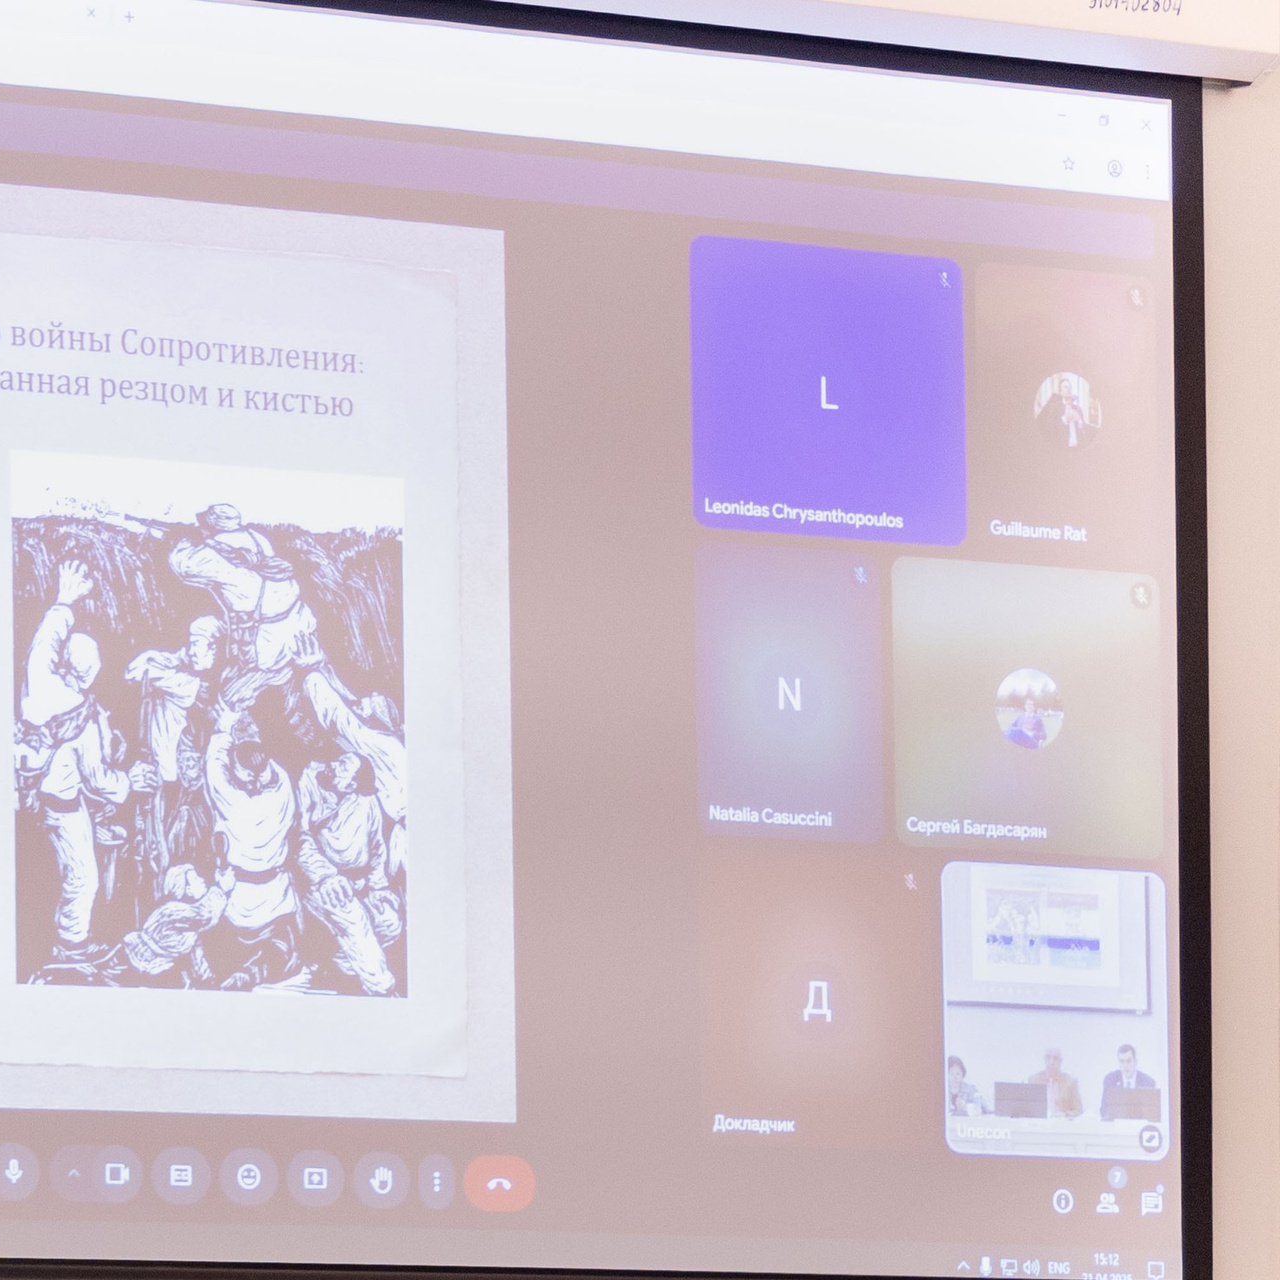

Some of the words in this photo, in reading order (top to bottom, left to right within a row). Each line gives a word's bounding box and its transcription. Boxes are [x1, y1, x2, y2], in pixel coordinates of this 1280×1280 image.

[10, 321, 112, 354] войны
[120, 328, 366, 375] Сопротивления:
[99, 376, 208, 408] резцом
[217, 387, 235, 408] и
[244, 388, 354, 418] кистью
[820, 376, 839, 410] L
[704, 498, 770, 519] Leonidas
[772, 503, 904, 530] Chrysanthopoulos
[989, 519, 1062, 542] Guillaume
[1063, 525, 1088, 542] Rat
[777, 676, 802, 712] N
[708, 804, 760, 824] Natalia
[761, 808, 833, 828] Casuccini
[906, 816, 961, 837] Сергей
[963, 818, 1048, 840] Багдасарян
[803, 980, 832, 1022] Д
[712, 1114, 796, 1135] Докладчик
[956, 1123, 1012, 1141] Unecon
[1047, 1261, 1070, 1276] ENG
[1093, 1252, 1120, 1267] 15:12
